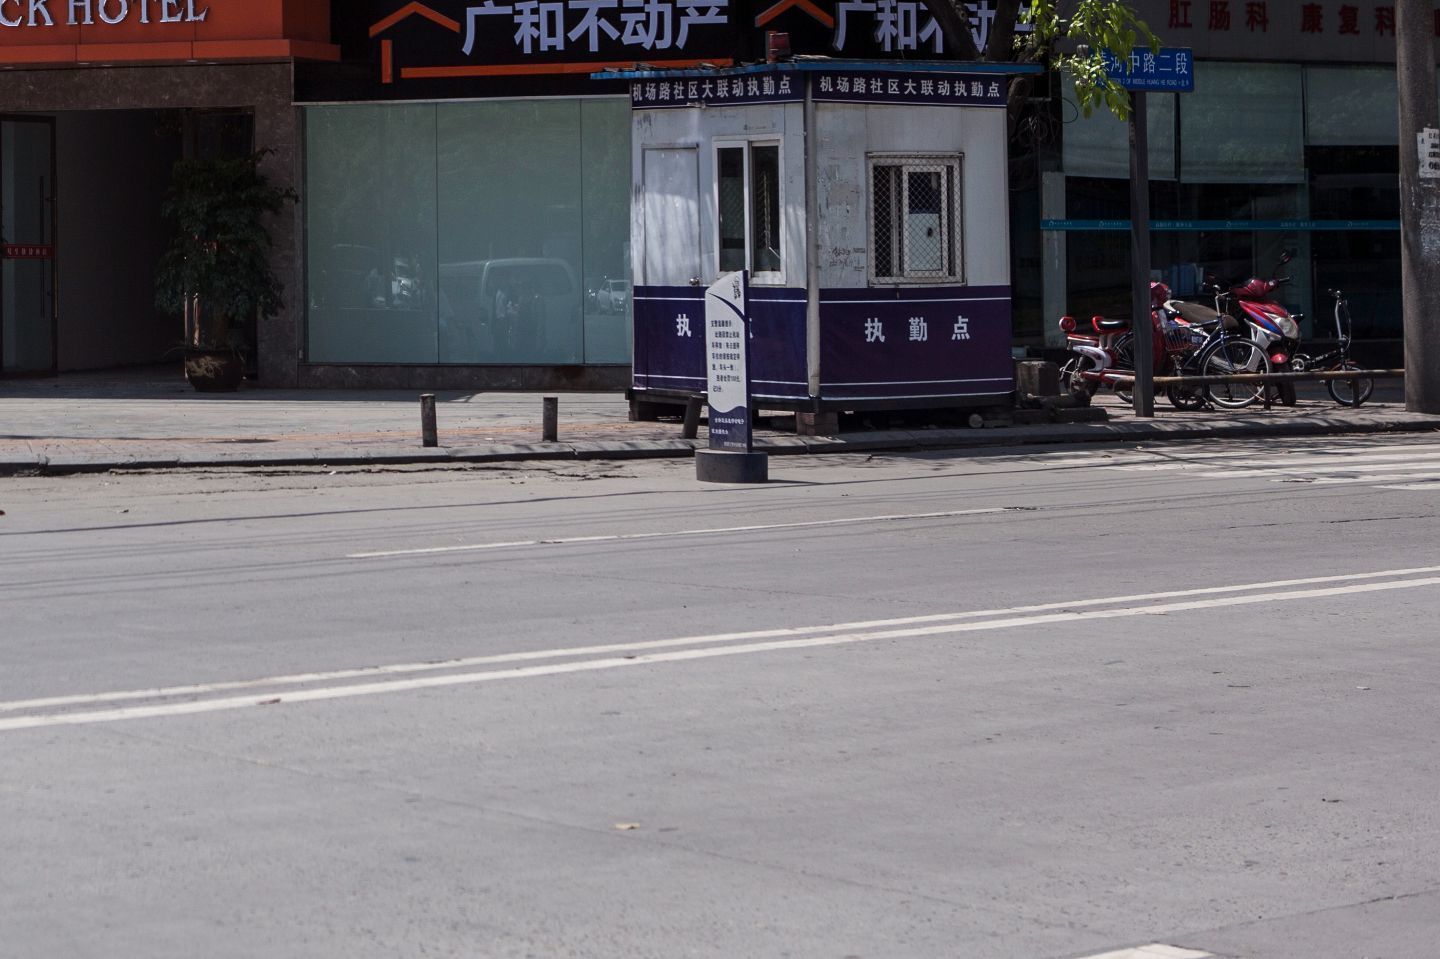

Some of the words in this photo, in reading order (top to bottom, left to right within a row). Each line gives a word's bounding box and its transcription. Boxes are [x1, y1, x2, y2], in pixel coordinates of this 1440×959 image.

[632, 75, 792, 102] 机场路社区大联动执勤点
[819, 75, 1000, 98] 机场路社区大联动执勤点
[864, 315, 971, 343] 执勤点
